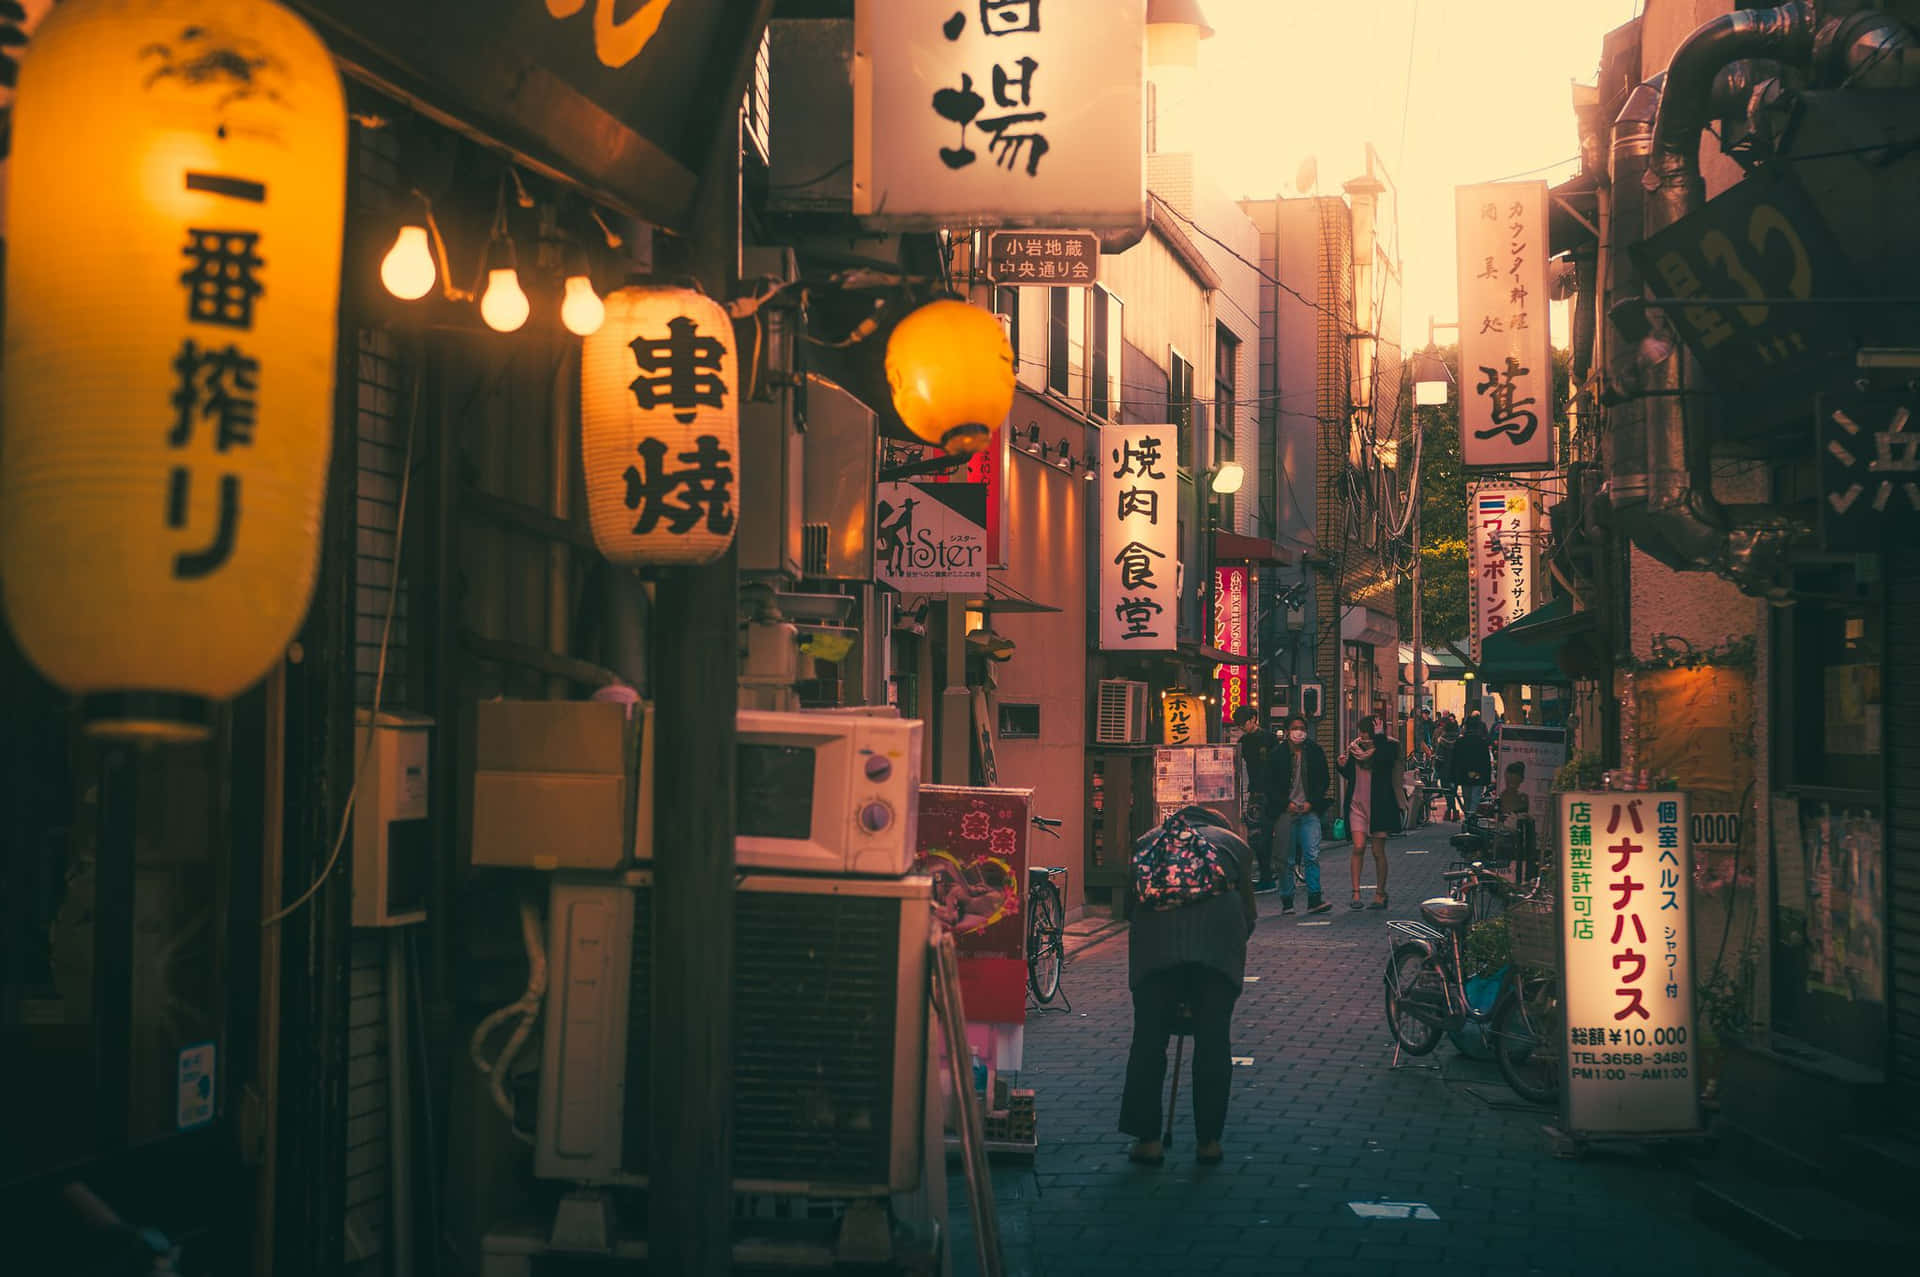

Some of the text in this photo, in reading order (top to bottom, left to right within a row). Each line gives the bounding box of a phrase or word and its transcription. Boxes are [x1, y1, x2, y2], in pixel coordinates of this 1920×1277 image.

[1000, 260, 1088, 278] 中央通り会
[1006, 239, 1083, 256] 小岩地蔵
[166, 171, 266, 582] 一番搾り
[622, 316, 735, 535] 串焼
[1112, 435, 1166, 640] 焼肉食堂
[1169, 699, 1192, 744] ホルモン
[1569, 801, 1594, 940] 店舗型許可店
[1606, 799, 1651, 1021] バナナハウス
[1656, 801, 1680, 999] 個室ヘルス シャワー付
